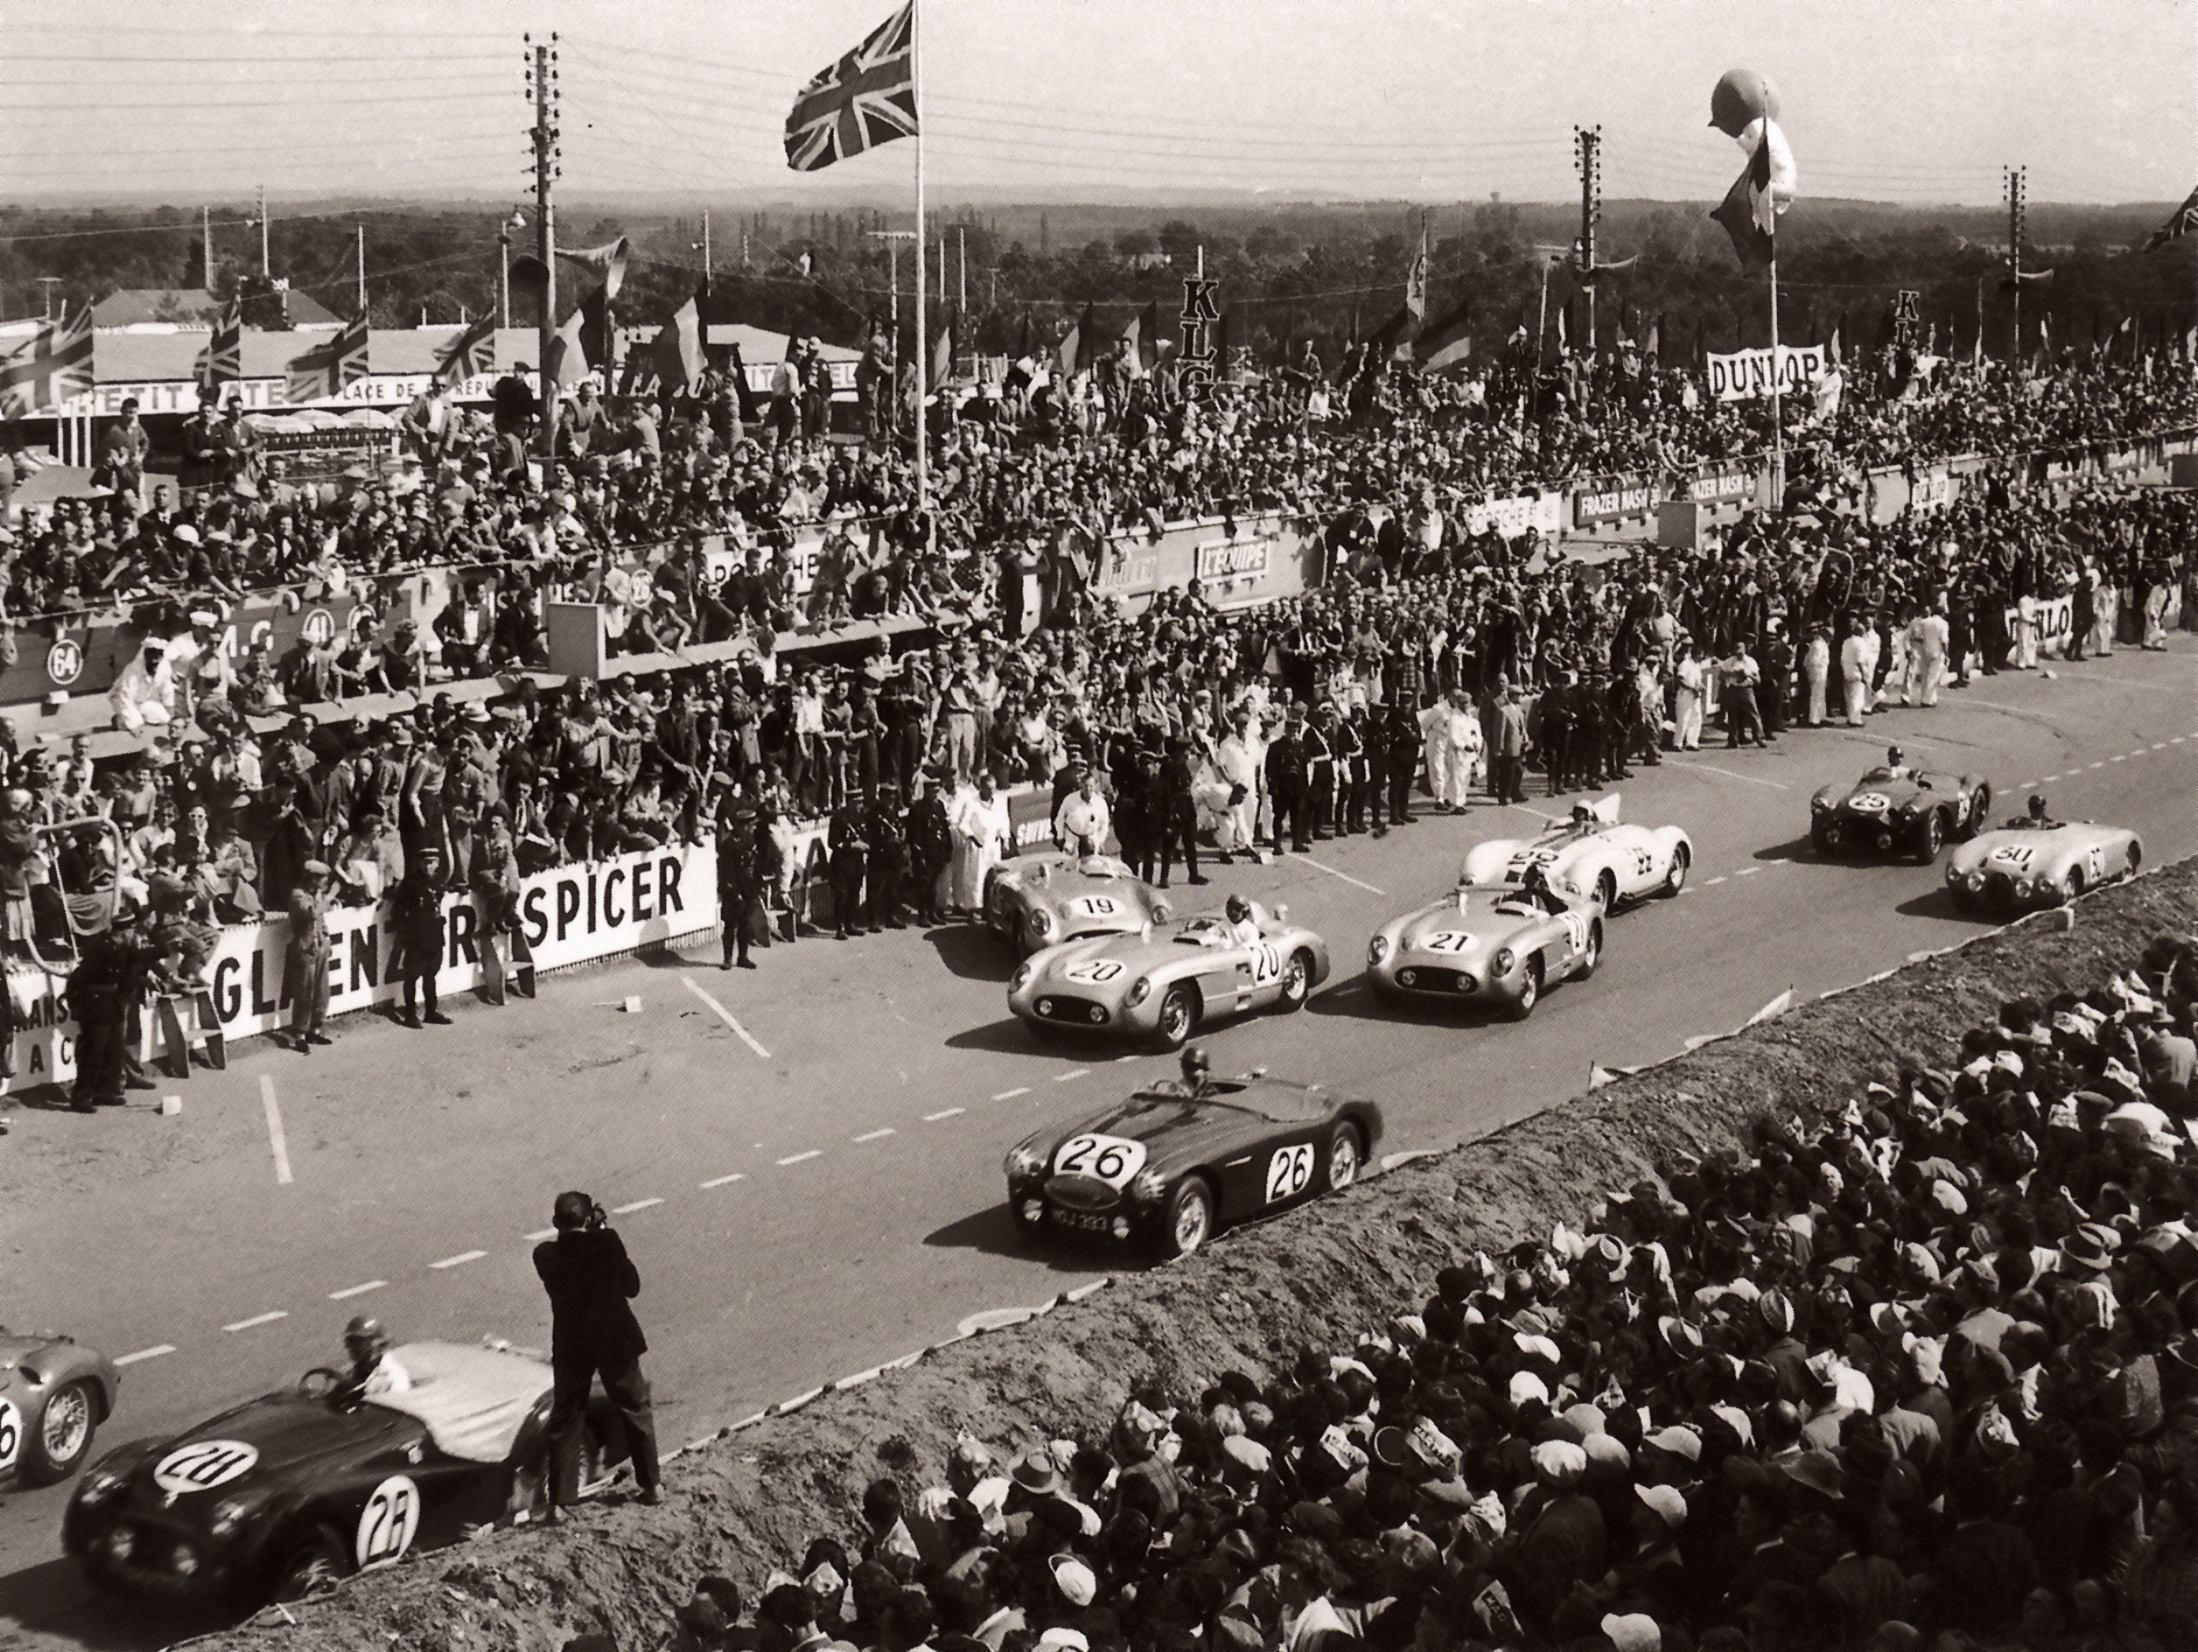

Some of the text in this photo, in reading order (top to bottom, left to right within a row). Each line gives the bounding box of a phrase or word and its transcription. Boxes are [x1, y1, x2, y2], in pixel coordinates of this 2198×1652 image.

[1713, 353, 1819, 394] DUNLOP
[104, 385, 182, 411] ETIT
[343, 383, 383, 400] LACE
[52, 649, 77, 677] 64
[523, 855, 684, 948] SPICER
[1082, 898, 1115, 914] 19
[1429, 933, 1469, 951] 21
[1069, 962, 1122, 981] 20
[1060, 1138, 1132, 1179] 26
[1271, 1147, 1309, 1198] 26
